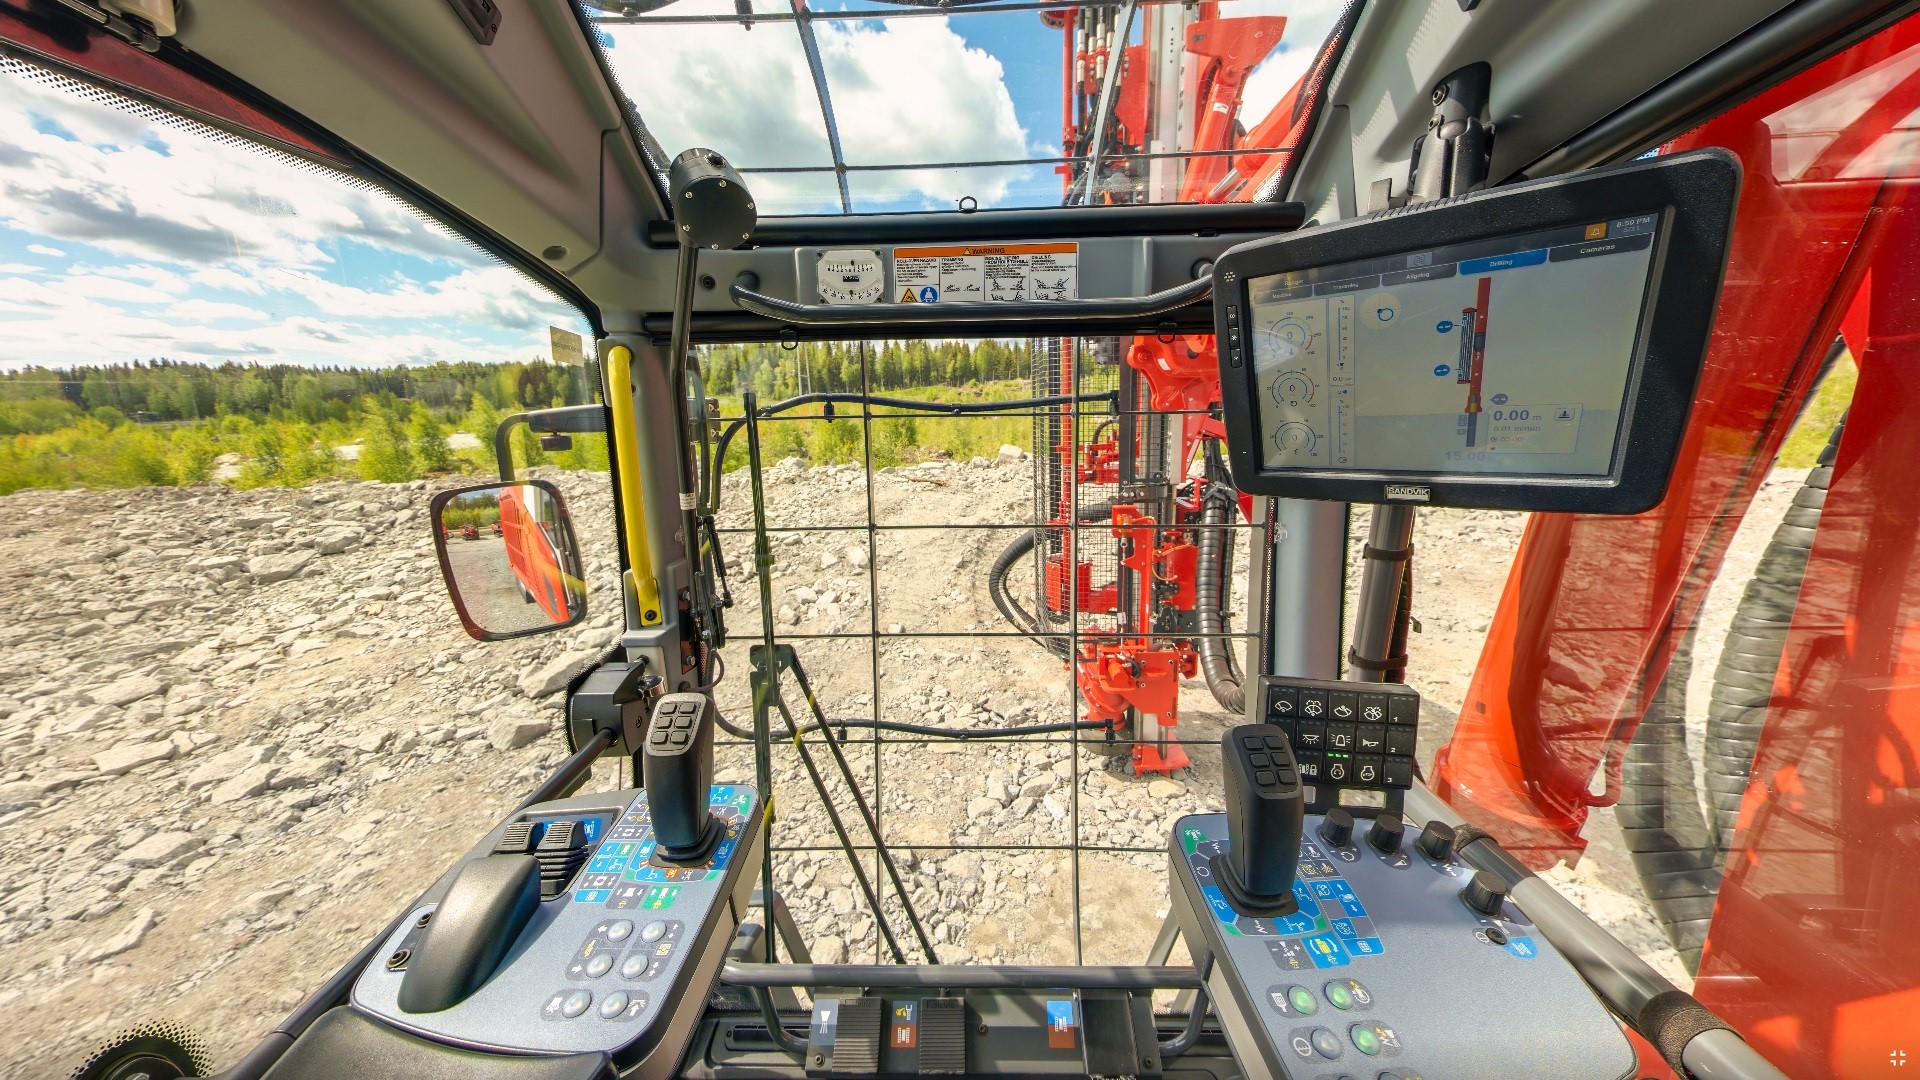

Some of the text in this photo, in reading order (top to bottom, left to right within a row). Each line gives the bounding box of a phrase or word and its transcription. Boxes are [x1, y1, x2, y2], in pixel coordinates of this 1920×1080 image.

[971, 247, 1005, 255] WARNING
[1580, 244, 1616, 254] Cameras
[1493, 409, 1530, 421] 0.00
[1388, 487, 1428, 496] SANDVIK
